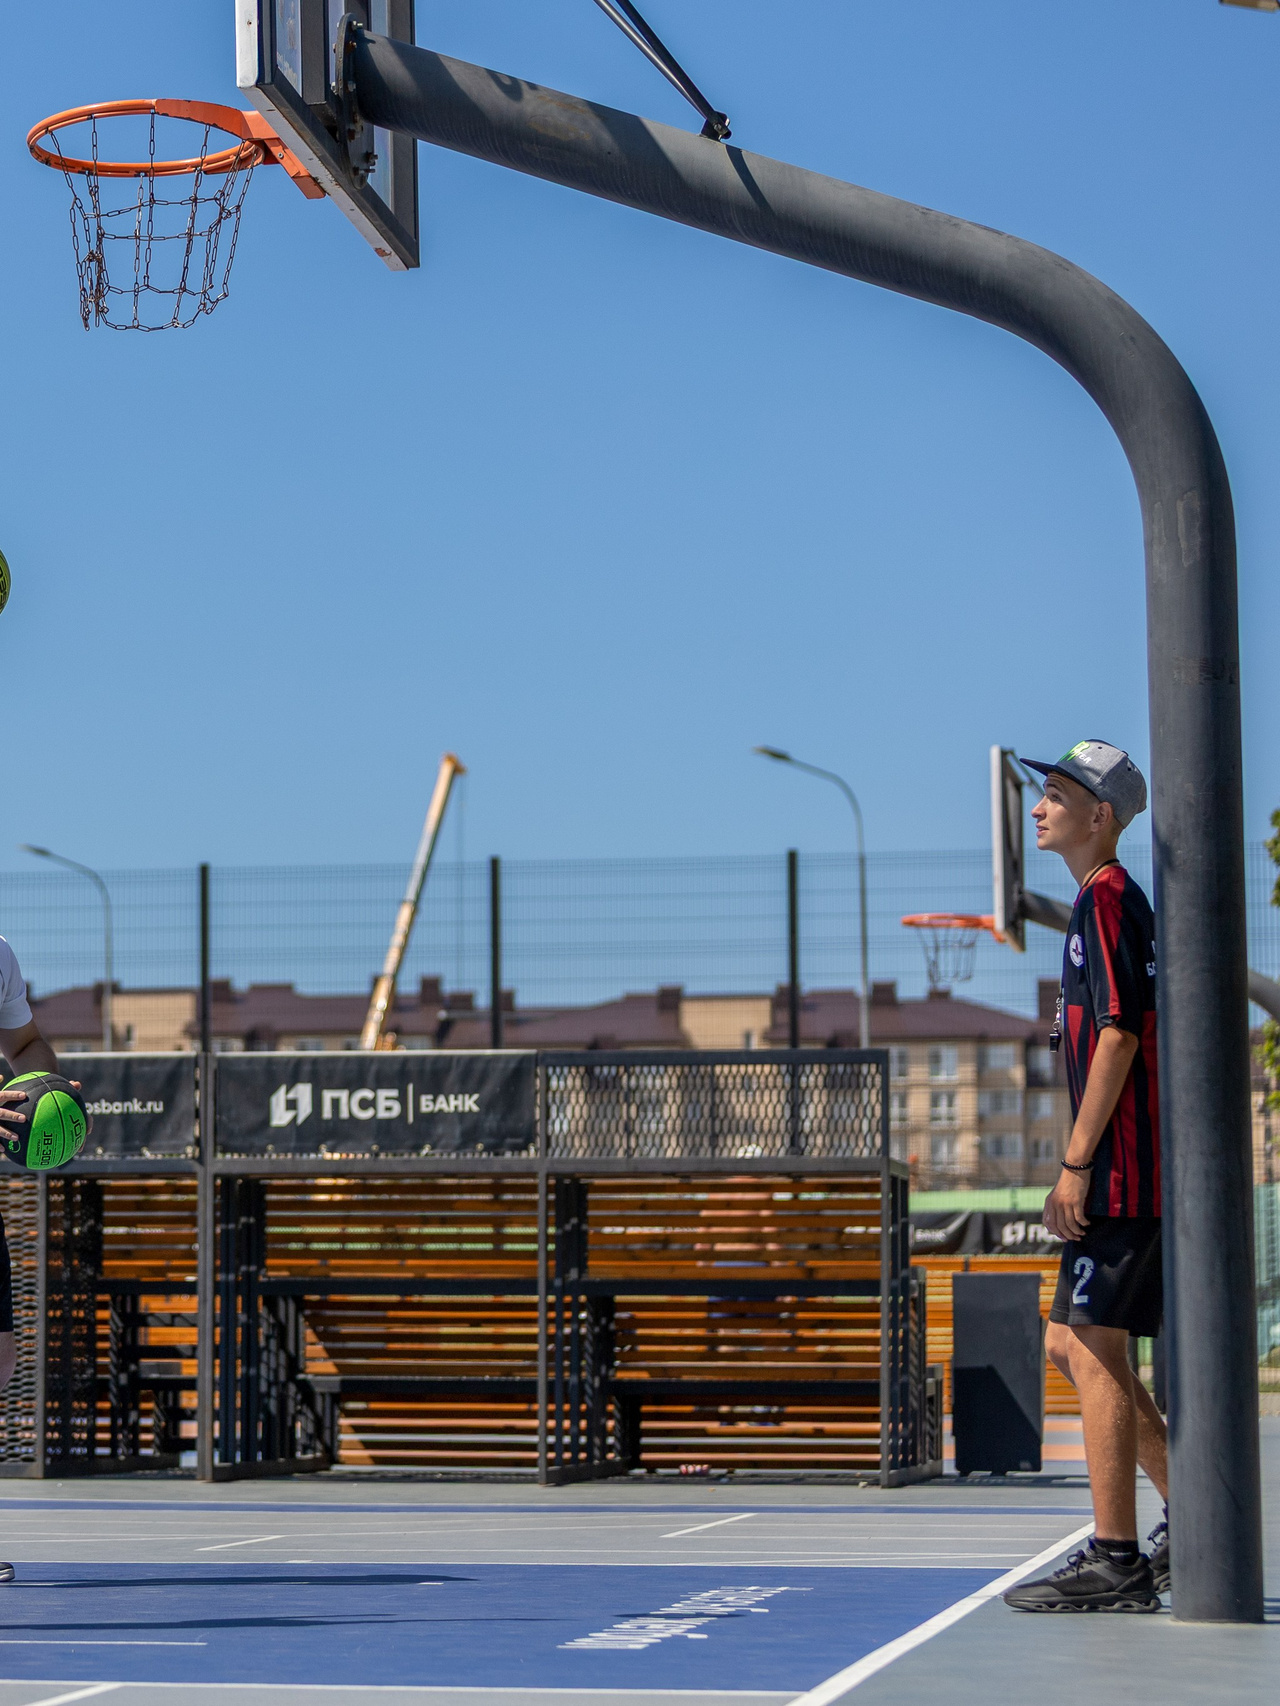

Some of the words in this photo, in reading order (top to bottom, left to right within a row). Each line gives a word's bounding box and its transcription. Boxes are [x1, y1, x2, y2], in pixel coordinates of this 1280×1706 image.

[321, 1087, 402, 1120] ПСБ
[420, 1093, 481, 1114] БАНК
[40, 1130, 53, 1166] JB-300
[1072, 1256, 1095, 1305] 2
